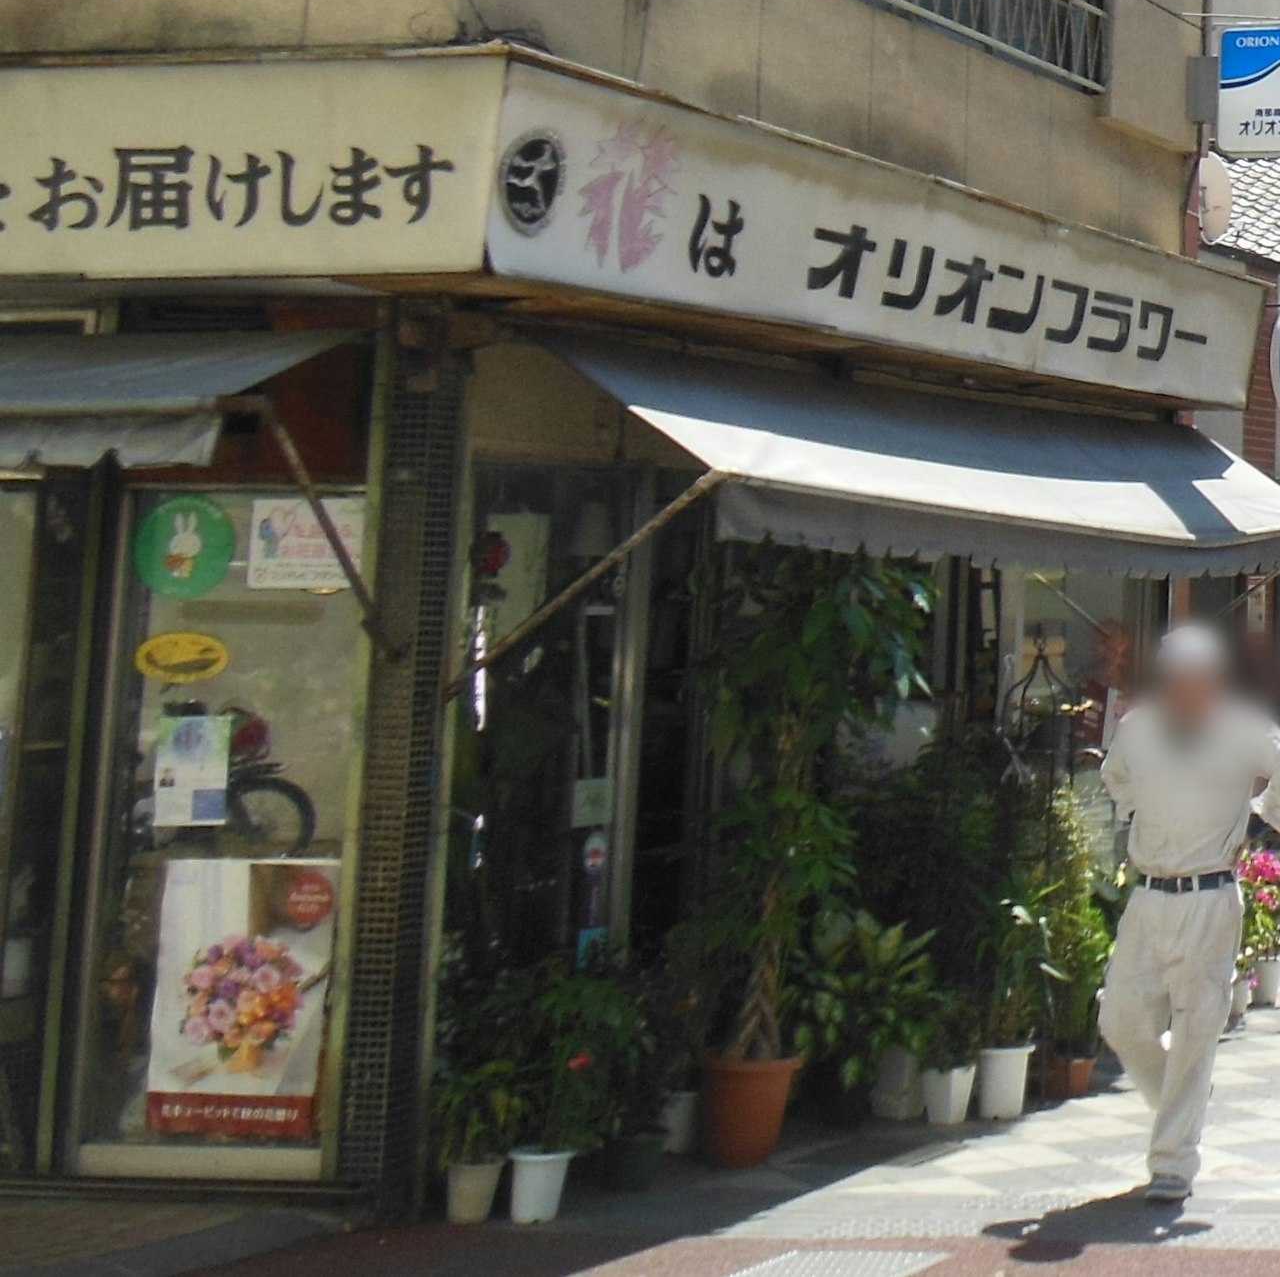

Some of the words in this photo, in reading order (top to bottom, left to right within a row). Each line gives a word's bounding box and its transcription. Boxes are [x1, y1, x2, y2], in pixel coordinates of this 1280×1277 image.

[1235, 35, 1280, 48] ORION
[0, 144, 455, 231] お届けします
[806, 223, 1208, 362] オリオンフラワー
